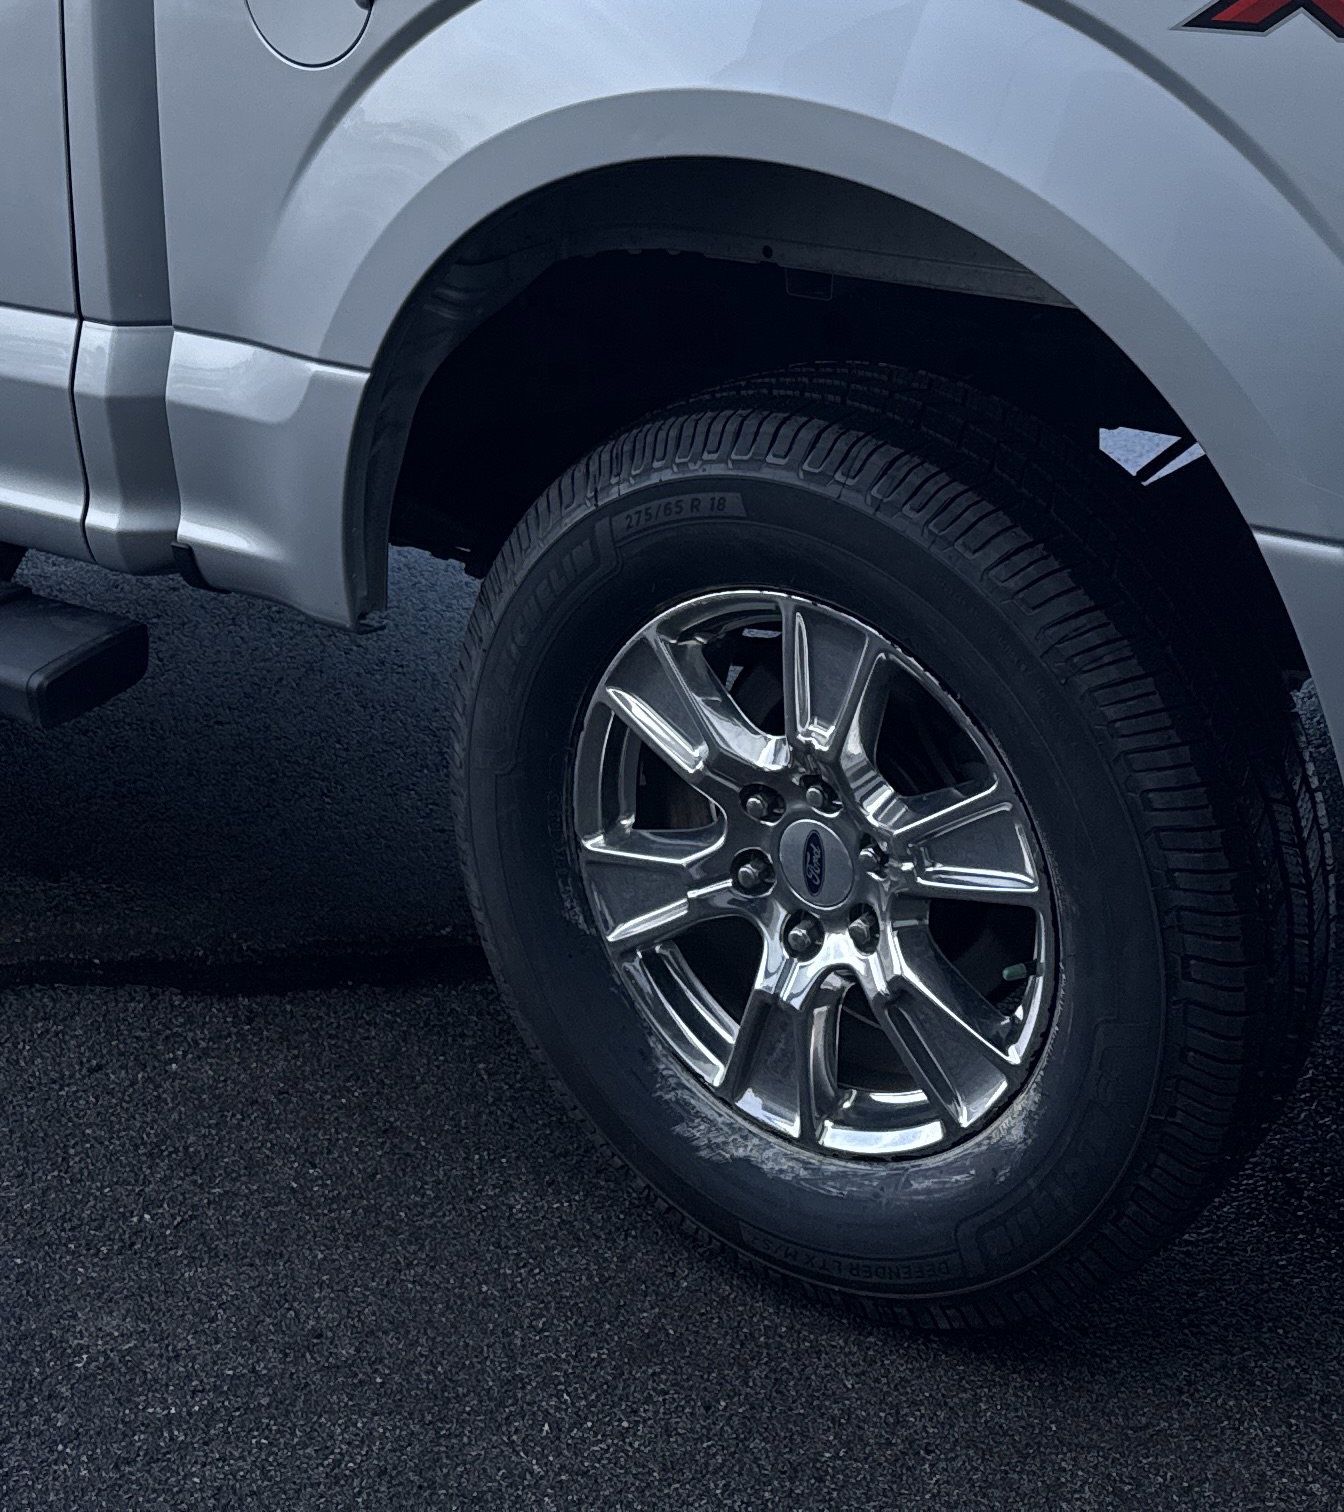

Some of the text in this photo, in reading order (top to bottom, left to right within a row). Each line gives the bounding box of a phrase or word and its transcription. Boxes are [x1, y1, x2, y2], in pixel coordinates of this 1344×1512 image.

[624, 496, 727, 530] 275/65 R 18
[492, 538, 594, 690] MICHELIN
[805, 842, 822, 886] Ford
[806, 1254, 842, 1277] LTX
[849, 1261, 951, 1281] DEFENDER
